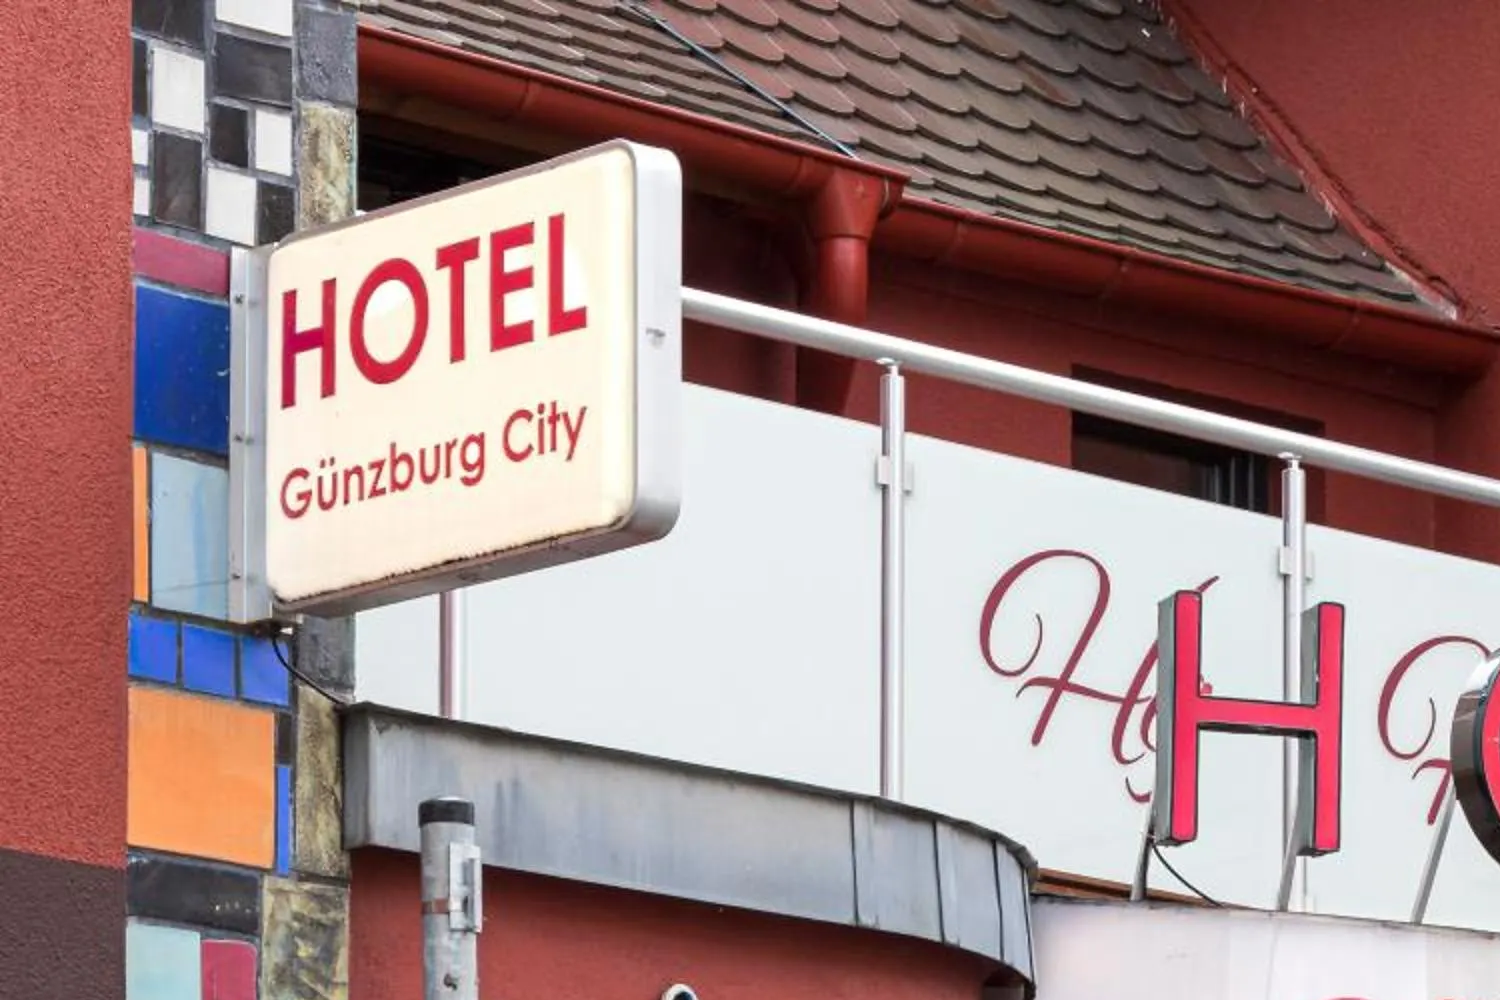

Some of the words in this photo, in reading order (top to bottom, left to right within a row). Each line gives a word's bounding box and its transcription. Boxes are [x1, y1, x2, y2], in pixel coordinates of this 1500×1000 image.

[281, 213, 588, 410] HOTEL
[279, 431, 486, 519] Günzburg
[502, 400, 588, 463] City
